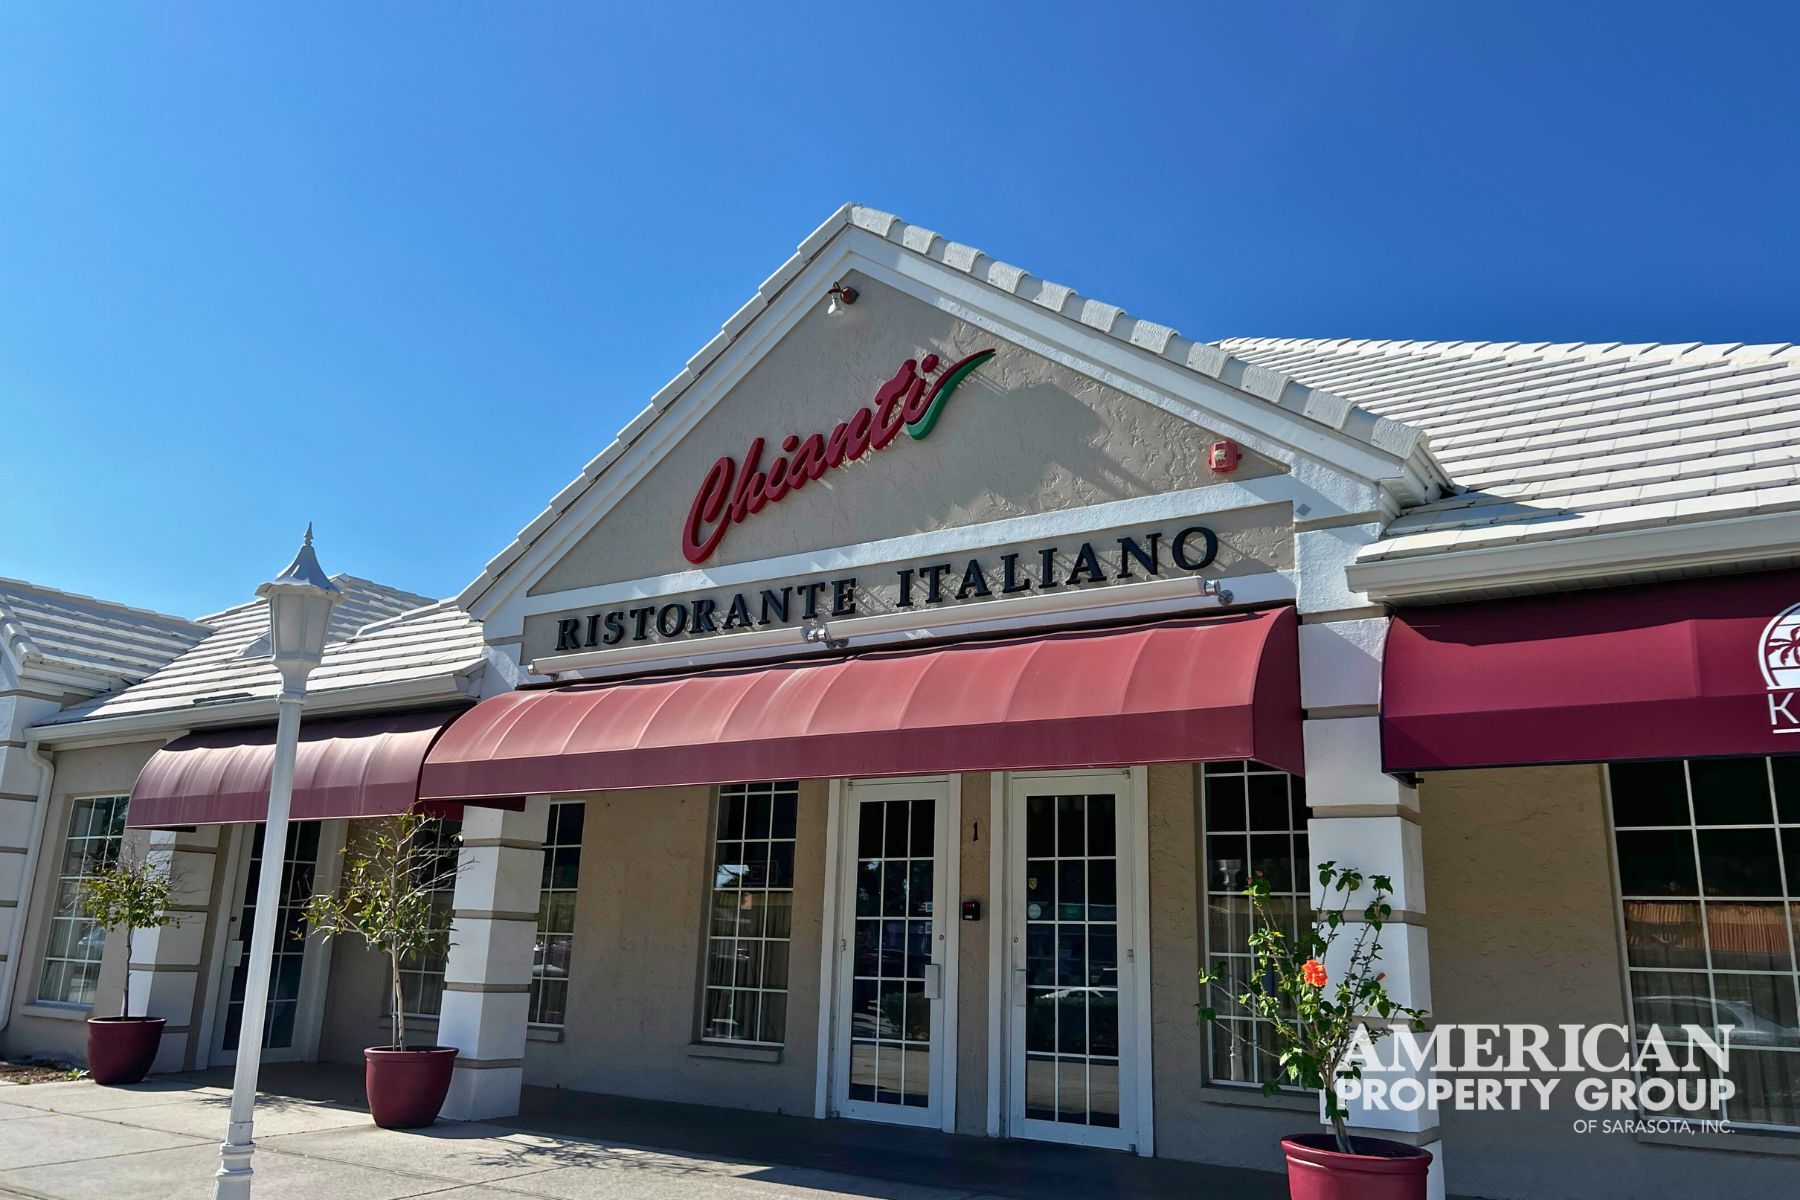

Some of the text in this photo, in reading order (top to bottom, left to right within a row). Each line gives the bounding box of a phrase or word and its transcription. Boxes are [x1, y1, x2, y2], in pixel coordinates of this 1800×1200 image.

[682, 348, 996, 564] Chianti
[556, 526, 1219, 651] RISTORANTE ITALIANO
